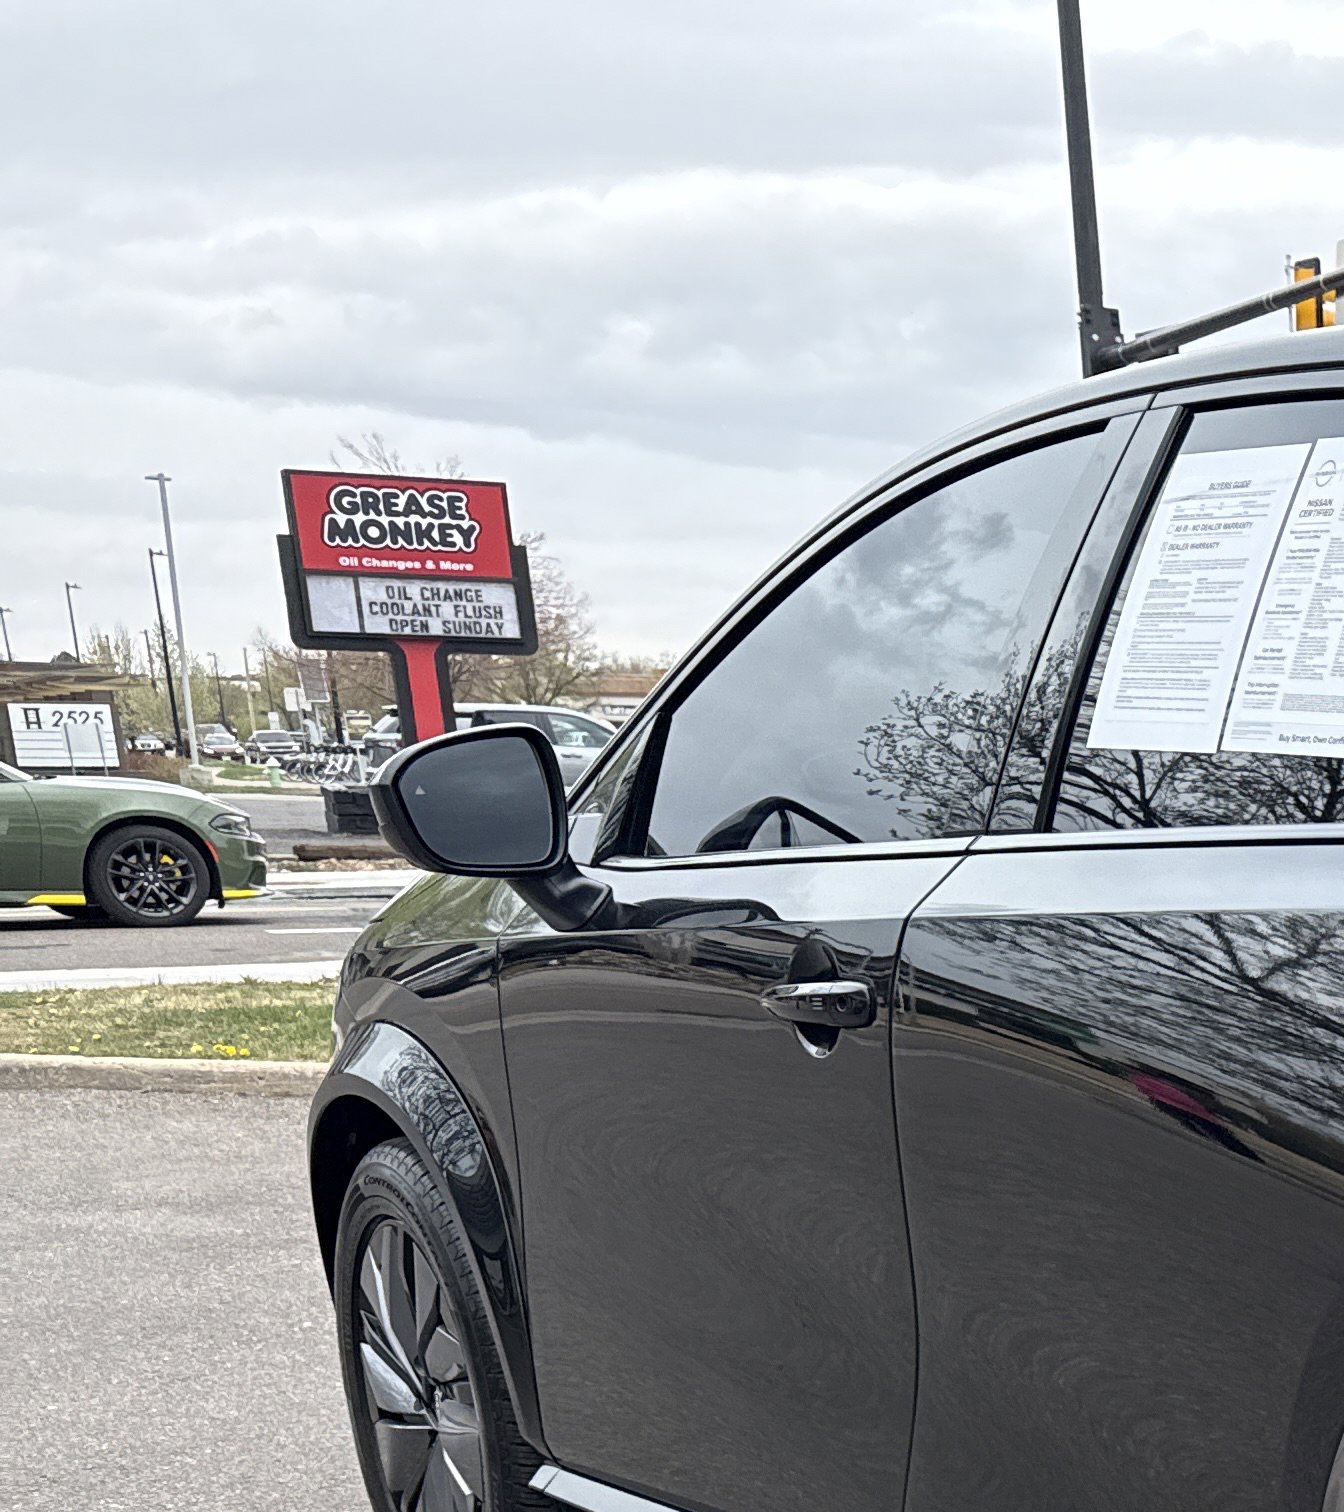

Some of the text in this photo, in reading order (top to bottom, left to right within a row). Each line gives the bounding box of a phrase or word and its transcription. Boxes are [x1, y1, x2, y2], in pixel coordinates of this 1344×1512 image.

[333, 488, 467, 520] GREASE
[326, 517, 477, 549] MONKEY
[339, 556, 474, 571] Oil Changes & More
[385, 585, 484, 603] OIL CHANGE
[369, 601, 504, 620] COOLANT FLUSH
[388, 618, 505, 636] OPEN SUNDAY
[52, 710, 104, 728] 2525
[1279, 734, 1291, 744] Buy
[1291, 734, 1312, 744] Smart,
[1312, 735, 1328, 744] Own
